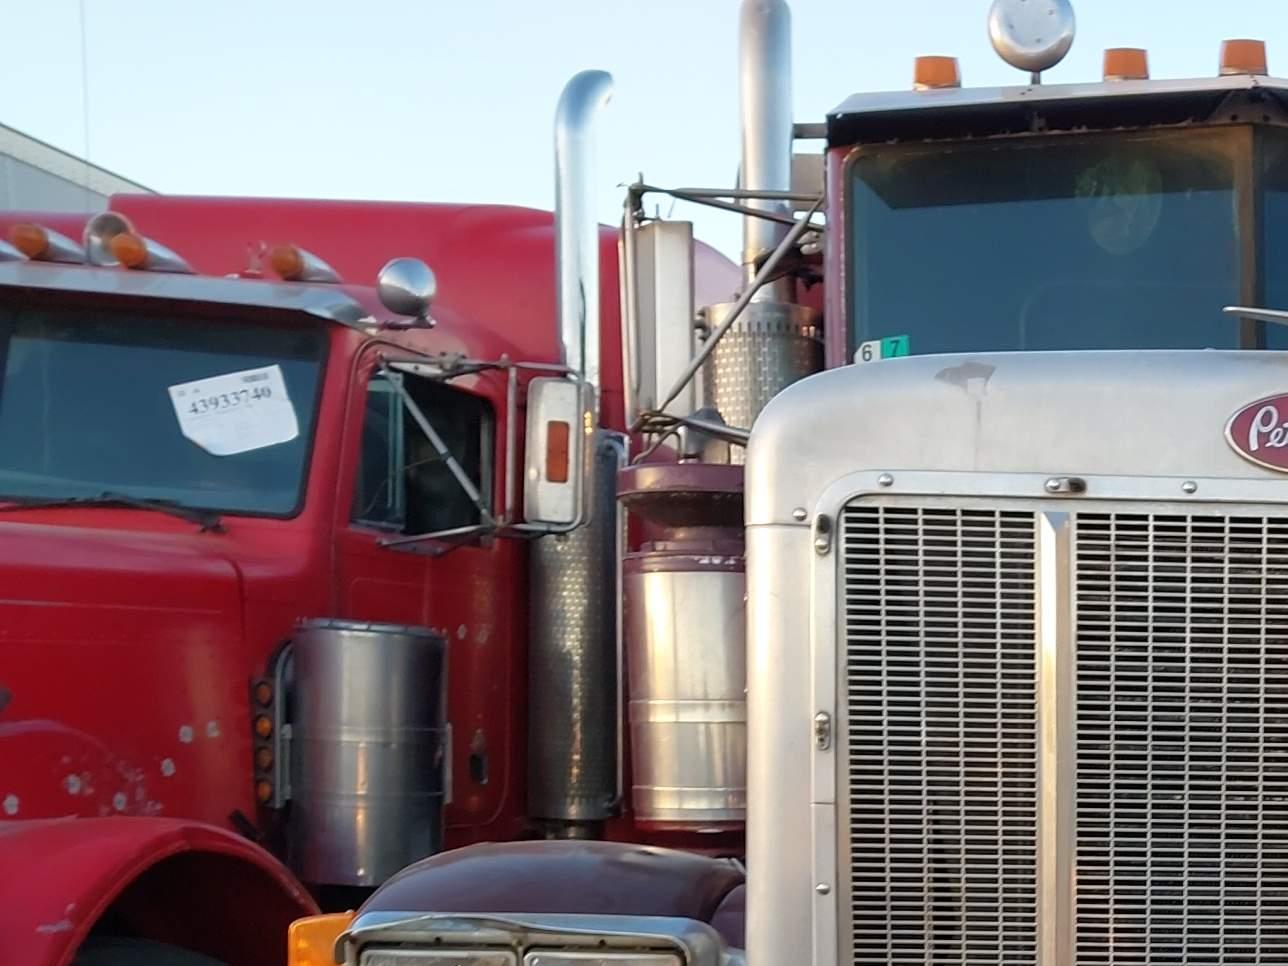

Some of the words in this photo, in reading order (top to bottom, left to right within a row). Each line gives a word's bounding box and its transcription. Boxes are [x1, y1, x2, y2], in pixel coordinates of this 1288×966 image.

[862, 344, 872, 361] 6
[890, 339, 900, 357] 7
[188, 385, 273, 415] 43933740
